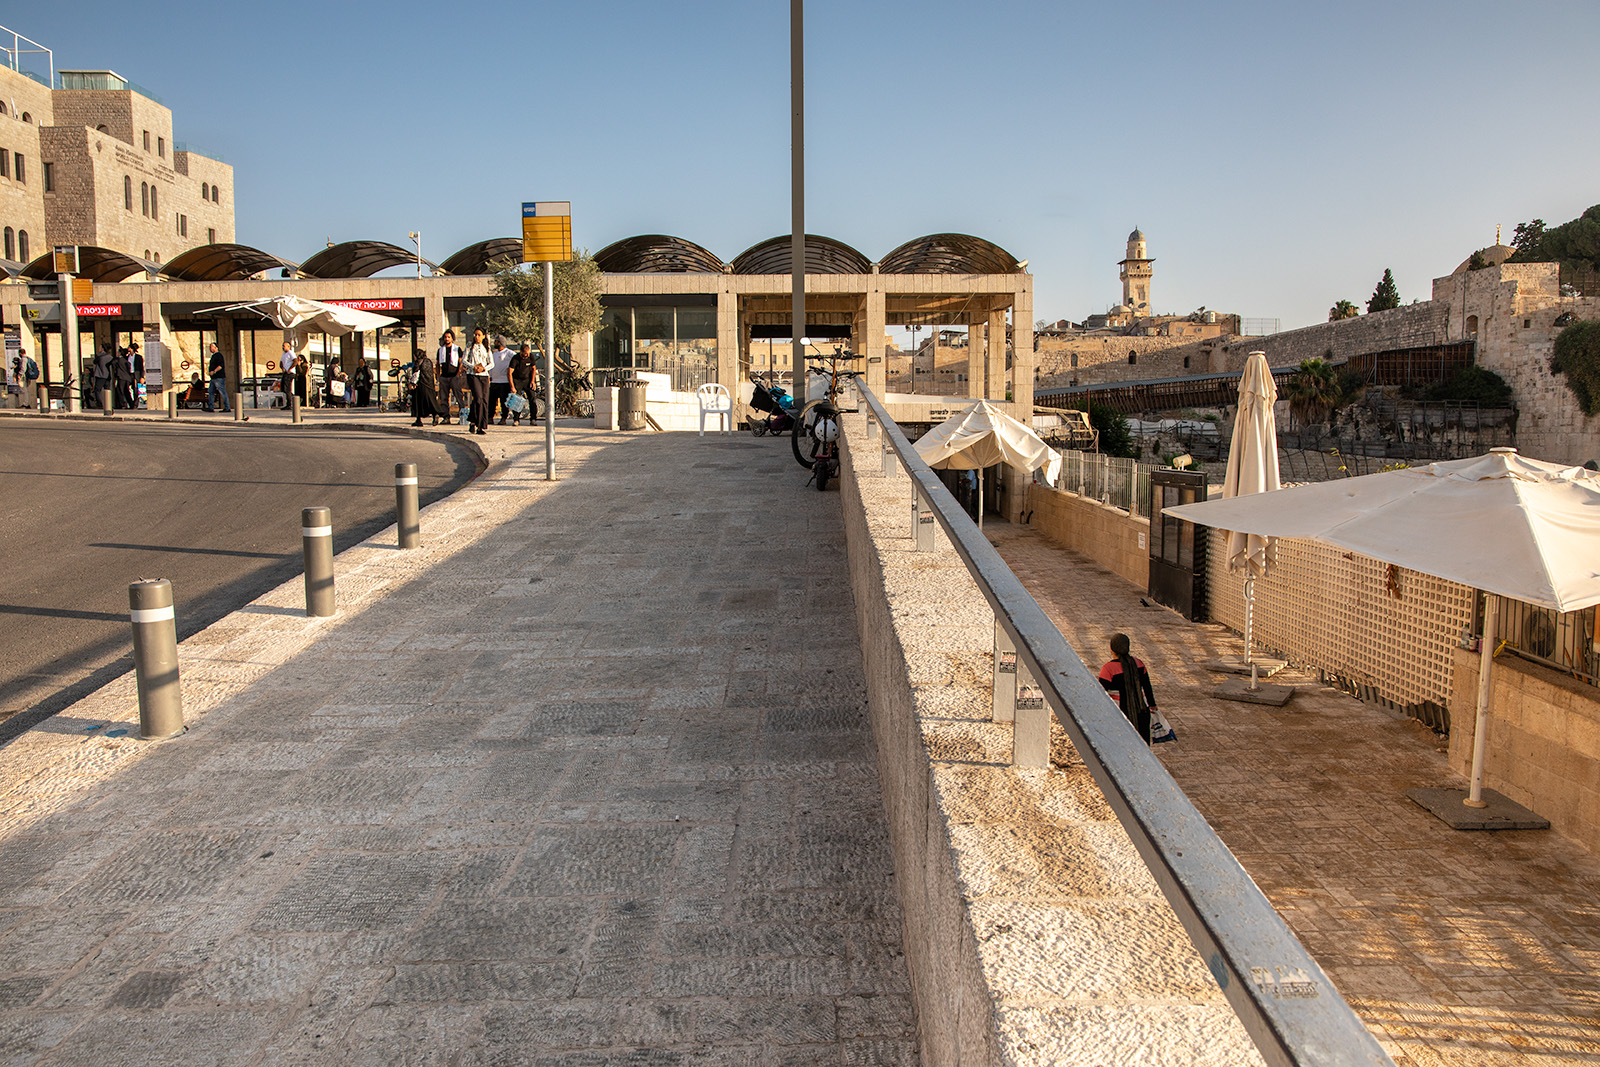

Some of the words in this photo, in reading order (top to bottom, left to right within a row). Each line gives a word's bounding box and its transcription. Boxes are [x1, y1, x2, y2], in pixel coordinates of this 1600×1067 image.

[364, 301, 387, 309] כניסה
[388, 301, 400, 310] אין
[108, 307, 119, 315] אין
